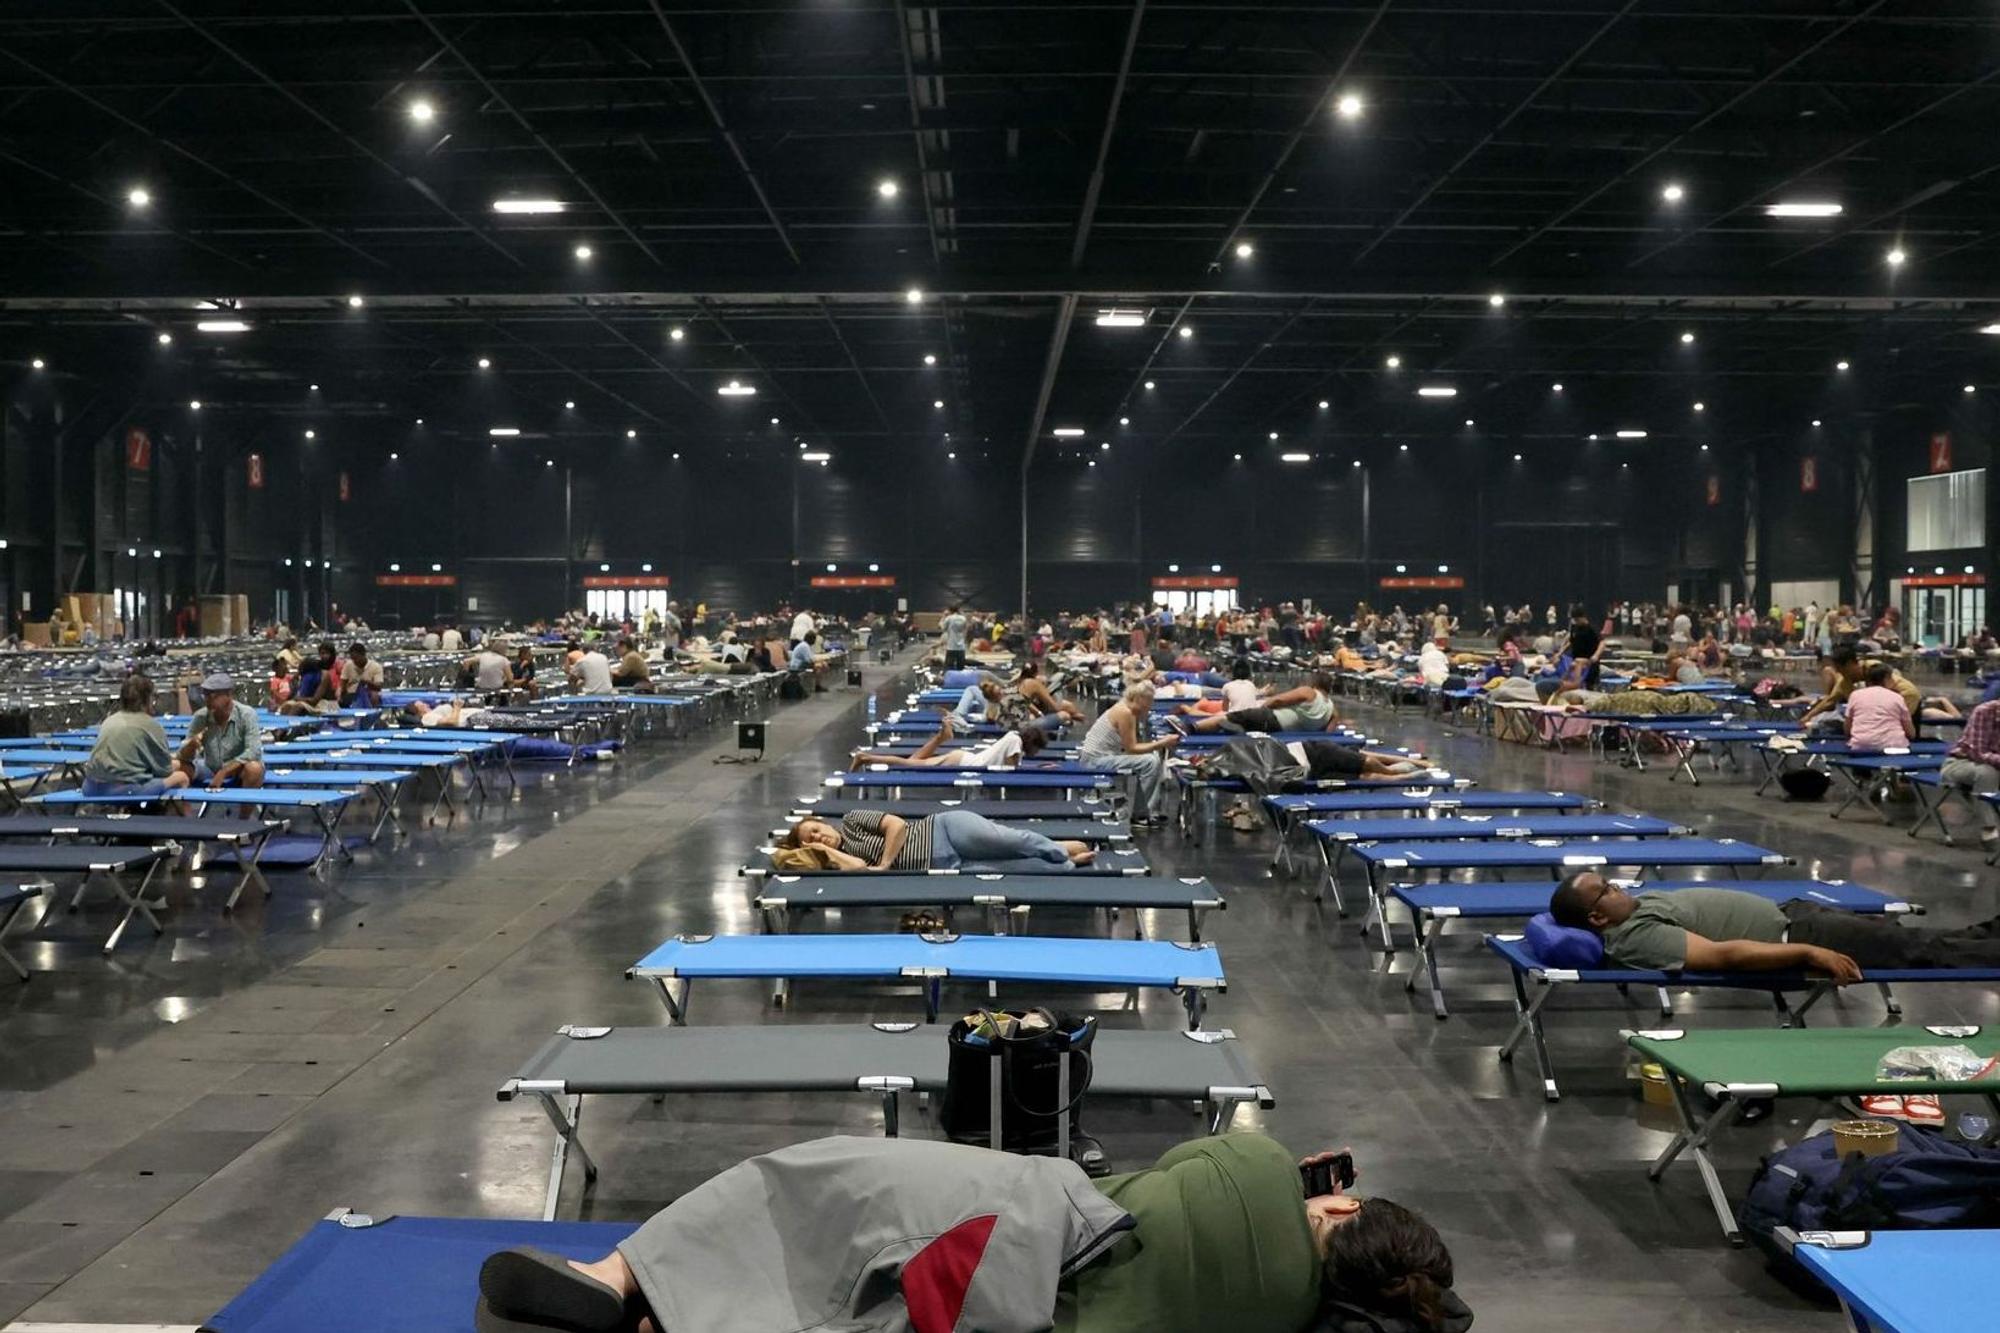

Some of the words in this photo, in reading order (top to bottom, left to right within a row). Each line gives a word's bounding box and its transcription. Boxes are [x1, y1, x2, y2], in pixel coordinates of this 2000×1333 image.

[132, 432, 146, 464] 7
[250, 454, 261, 484] 8
[1803, 458, 1815, 488] 8
